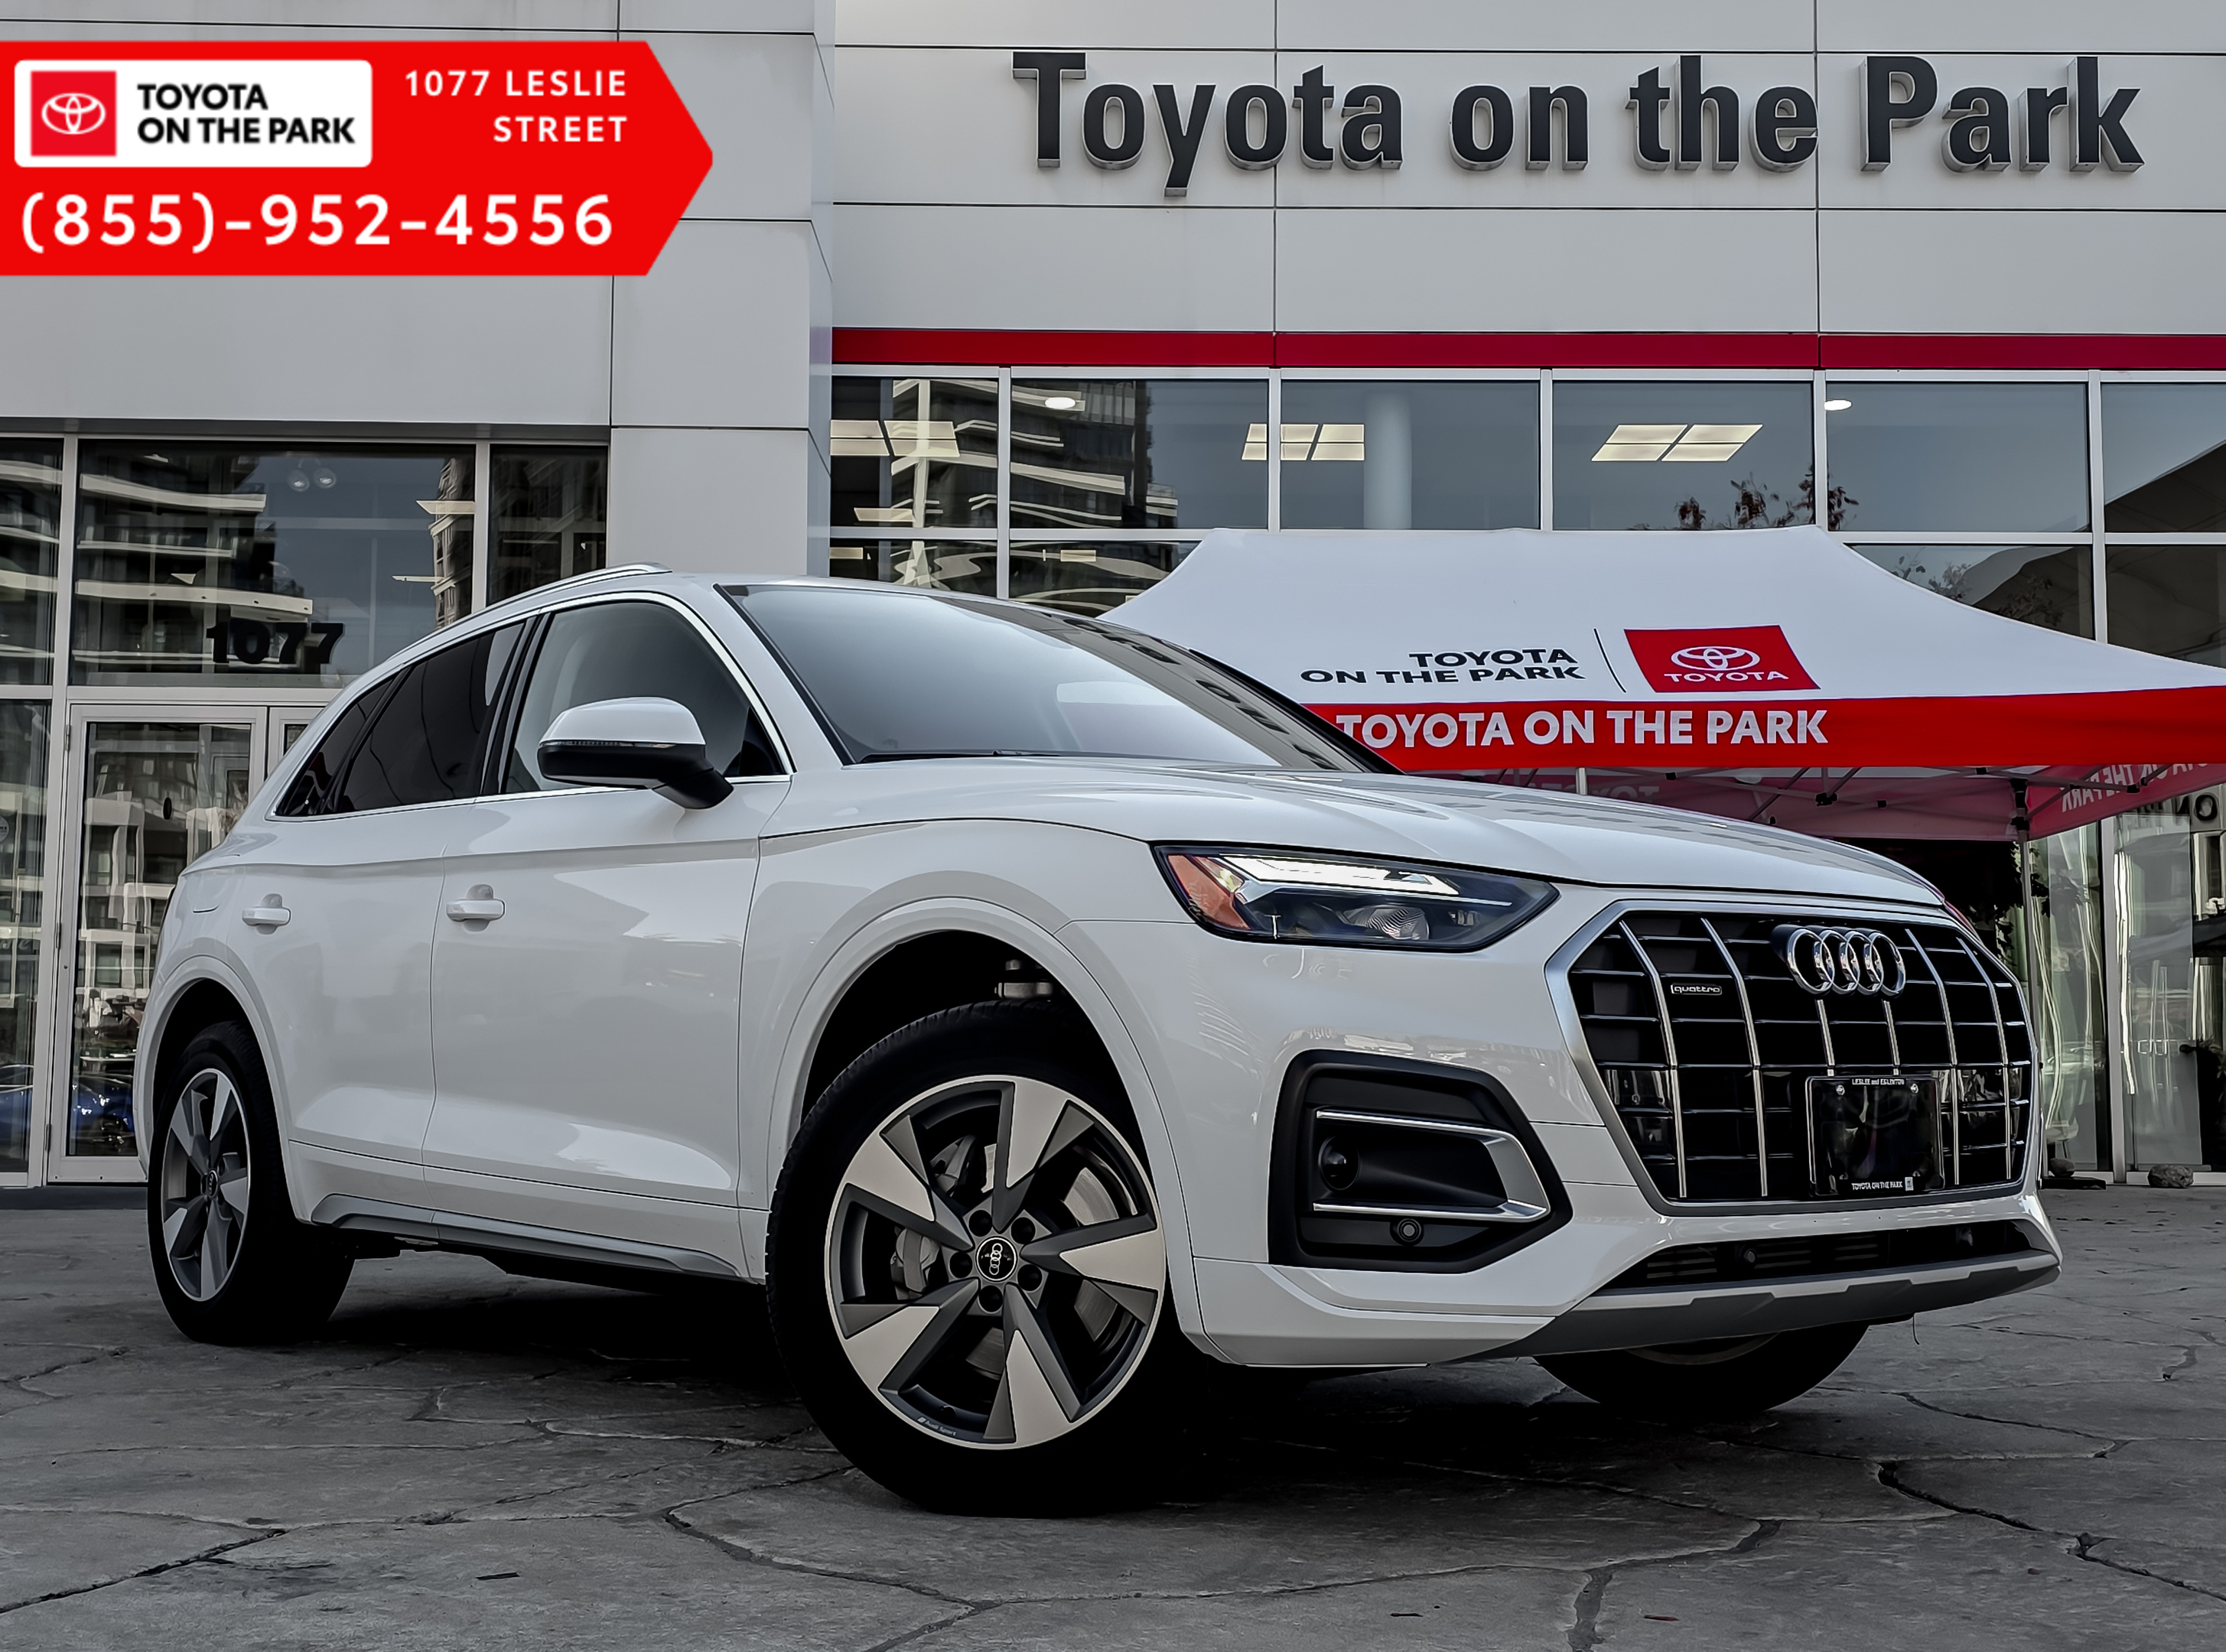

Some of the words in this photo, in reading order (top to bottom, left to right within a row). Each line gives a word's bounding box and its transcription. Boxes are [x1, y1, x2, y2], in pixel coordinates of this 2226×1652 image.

[1012, 51, 1403, 197] Toyota
[1448, 82, 1588, 170] on
[1625, 54, 1819, 173] the
[1860, 54, 2145, 173] Park
[206, 621, 344, 664] 1077
[1408, 648, 1578, 667] TOYOTA
[1300, 670, 1367, 683] ON
[1375, 670, 1459, 683] THE
[1469, 666, 1586, 681] PARK
[1664, 671, 1789, 682] TOYOTA
[1336, 712, 1515, 749] TOYOTA
[1524, 710, 1594, 745] ON
[1606, 710, 1693, 744] THE
[1707, 710, 1828, 744] PARK
[1674, 985, 1720, 993] quattro
[925, 1420, 939, 1429] Audi
[940, 1426, 956, 1436] Sport
